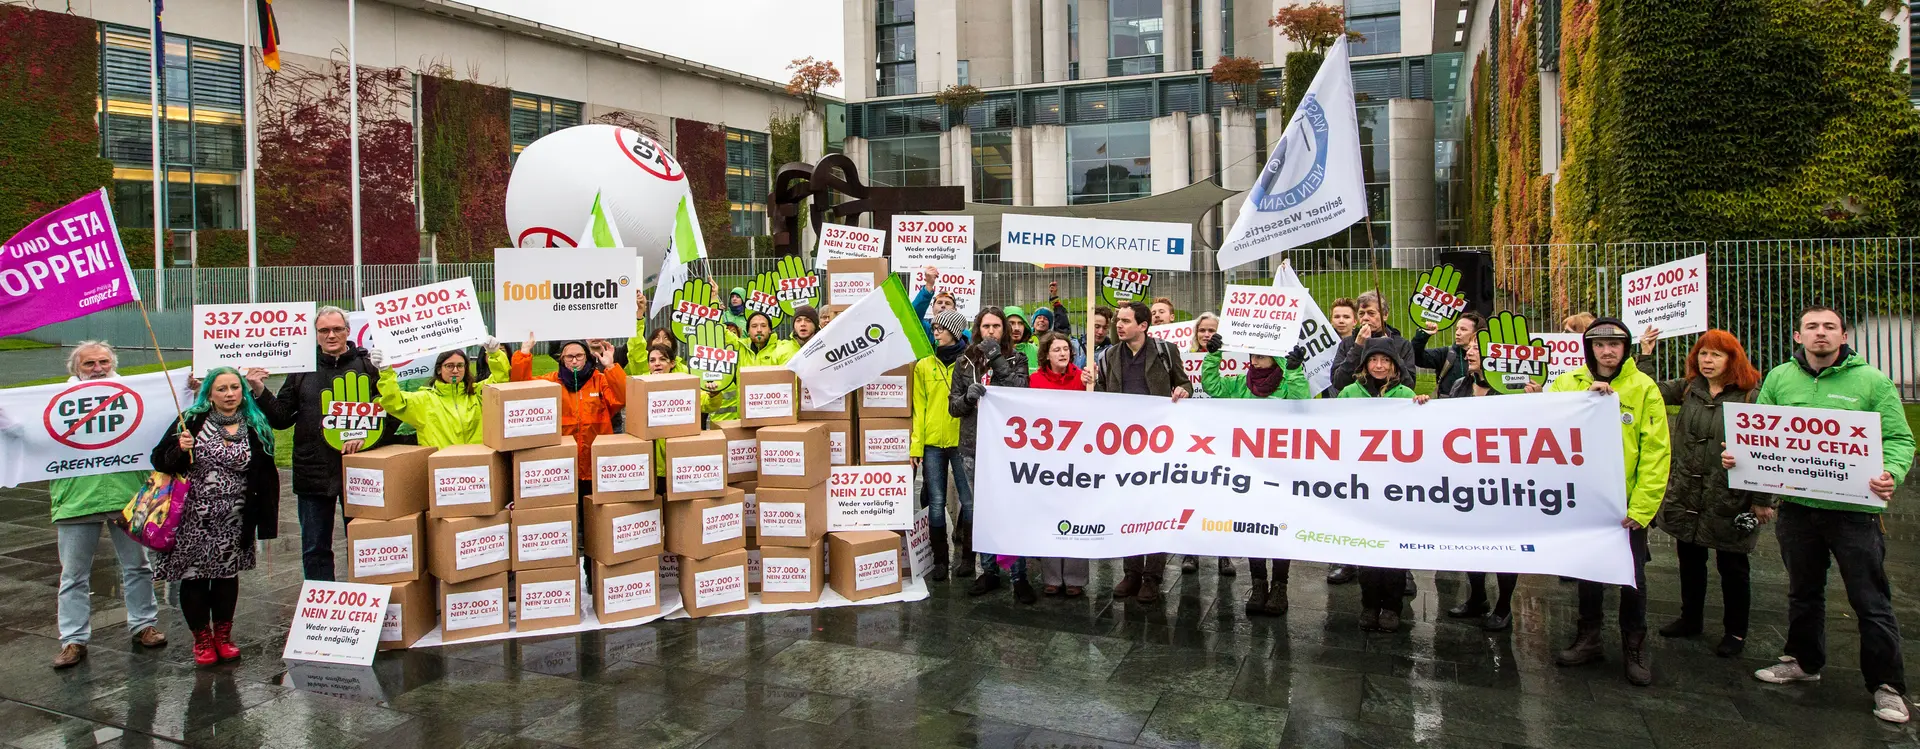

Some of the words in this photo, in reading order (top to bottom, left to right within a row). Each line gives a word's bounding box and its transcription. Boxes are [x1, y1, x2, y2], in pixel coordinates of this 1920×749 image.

[10, 236, 50, 259] UND
[47, 211, 105, 246] CETA
[898, 221, 954, 233] 337.000
[825, 228, 870, 243] 337.000
[897, 235, 922, 244] NEIN
[925, 235, 939, 244] ZU
[941, 235, 967, 244] CETA!
[1007, 231, 1056, 247] MEHR
[1061, 234, 1161, 252] DEMOKRATIE
[823, 239, 843, 248] NEIN
[845, 242, 856, 250] ZU
[857, 244, 879, 253] CETA!
[926, 245, 956, 253] vorläufig
[0, 240, 115, 297] OPPEN!
[1109, 266, 1149, 283] STOP
[780, 275, 818, 291] STOP
[1102, 276, 1142, 294] CETA!
[1628, 267, 1684, 293] 337.000
[1688, 268, 1698, 279] x
[502, 278, 618, 301] foodwatch
[776, 286, 815, 302] CETA!
[1422, 285, 1465, 309] STOP
[1627, 293, 1651, 307] NEIN
[1654, 289, 1668, 301] ZU
[1671, 282, 1699, 297] CETA!
[375, 289, 450, 315] 337.000
[455, 288, 468, 299] x
[752, 290, 777, 306] STO
[1230, 291, 1286, 308] 337.000
[1289, 299, 1299, 308] x
[1412, 293, 1456, 319] CETA!
[377, 313, 411, 329] NEIN
[415, 309, 433, 321] ZU
[437, 301, 471, 315] CETA!
[553, 303, 566, 312] die
[568, 302, 618, 311] essensretter
[679, 301, 719, 318] STOP
[745, 300, 781, 318] CETA!
[1226, 307, 1250, 318] NEIN
[1252, 309, 1267, 319] ZU
[1269, 310, 1297, 321] CETA!
[204, 310, 288, 326] 337.000
[293, 313, 307, 322] x
[671, 312, 706, 325] CETA
[203, 328, 240, 340] NEIN
[245, 327, 265, 338] ZU
[270, 326, 307, 337] CETA!
[214, 342, 245, 350] Weder
[248, 340, 290, 349] vorläufig
[1490, 344, 1547, 361] STOP
[245, 350, 292, 358] endgültig!
[695, 345, 736, 362] STOP
[688, 357, 731, 373] CETA!
[1482, 357, 1540, 375] CETA!
[58, 394, 129, 417] CETA
[332, 402, 385, 417] STOP
[508, 407, 545, 418] 337.000
[63, 414, 125, 436] TTIP
[322, 415, 378, 430] CETA!
[1736, 412, 1841, 436] 337.000
[1849, 426, 1868, 439] x
[1003, 415, 1175, 455] 337.000
[1186, 434, 1216, 455] x
[1231, 427, 1340, 461] NEIN
[1357, 429, 1424, 463] ZU
[1442, 427, 1585, 467] CETA!
[1736, 433, 1780, 448] NEIN
[1786, 437, 1811, 451] ZU
[1817, 440, 1869, 457] CETA!
[45, 453, 144, 474] GREENPEACE
[1750, 451, 1787, 462] Weder
[1790, 456, 1846, 470] vorläufig
[831, 472, 892, 485] 337.000
[897, 475, 906, 483] x
[1757, 464, 1784, 473] noch
[1788, 467, 1849, 482] endgültig!
[830, 488, 857, 498] NEIN
[860, 487, 875, 497] ZU
[878, 487, 907, 496] CETA!
[1009, 461, 1106, 489] Weder
[1115, 462, 1251, 494] vorläufig
[1292, 473, 1369, 500] noch
[1383, 476, 1577, 516] endgültig!
[860, 508, 895, 516] endgültig!
[862, 500, 894, 508] vorläufig
[1072, 524, 1106, 535] BUND
[1120, 508, 1195, 535] campact!
[1201, 517, 1279, 536] foodwatch
[1294, 529, 1389, 549] GREENPEACE
[1399, 542, 1435, 550] MEHR
[1439, 544, 1517, 552] DEMOKRATIE
[358, 546, 399, 556] 337.000
[358, 556, 376, 564] NEIN
[608, 581, 643, 594] 337.000
[608, 593, 624, 601] NEIN
[635, 588, 652, 596] CETA!
[306, 588, 367, 607] 337.000
[370, 597, 381, 608] x
[301, 607, 329, 619] NEIN
[330, 609, 345, 621] ZU
[348, 611, 378, 623] CETA!
[305, 623, 328, 631] Weder
[329, 625, 360, 635] vorläufig
[323, 635, 359, 645] endgültig!
